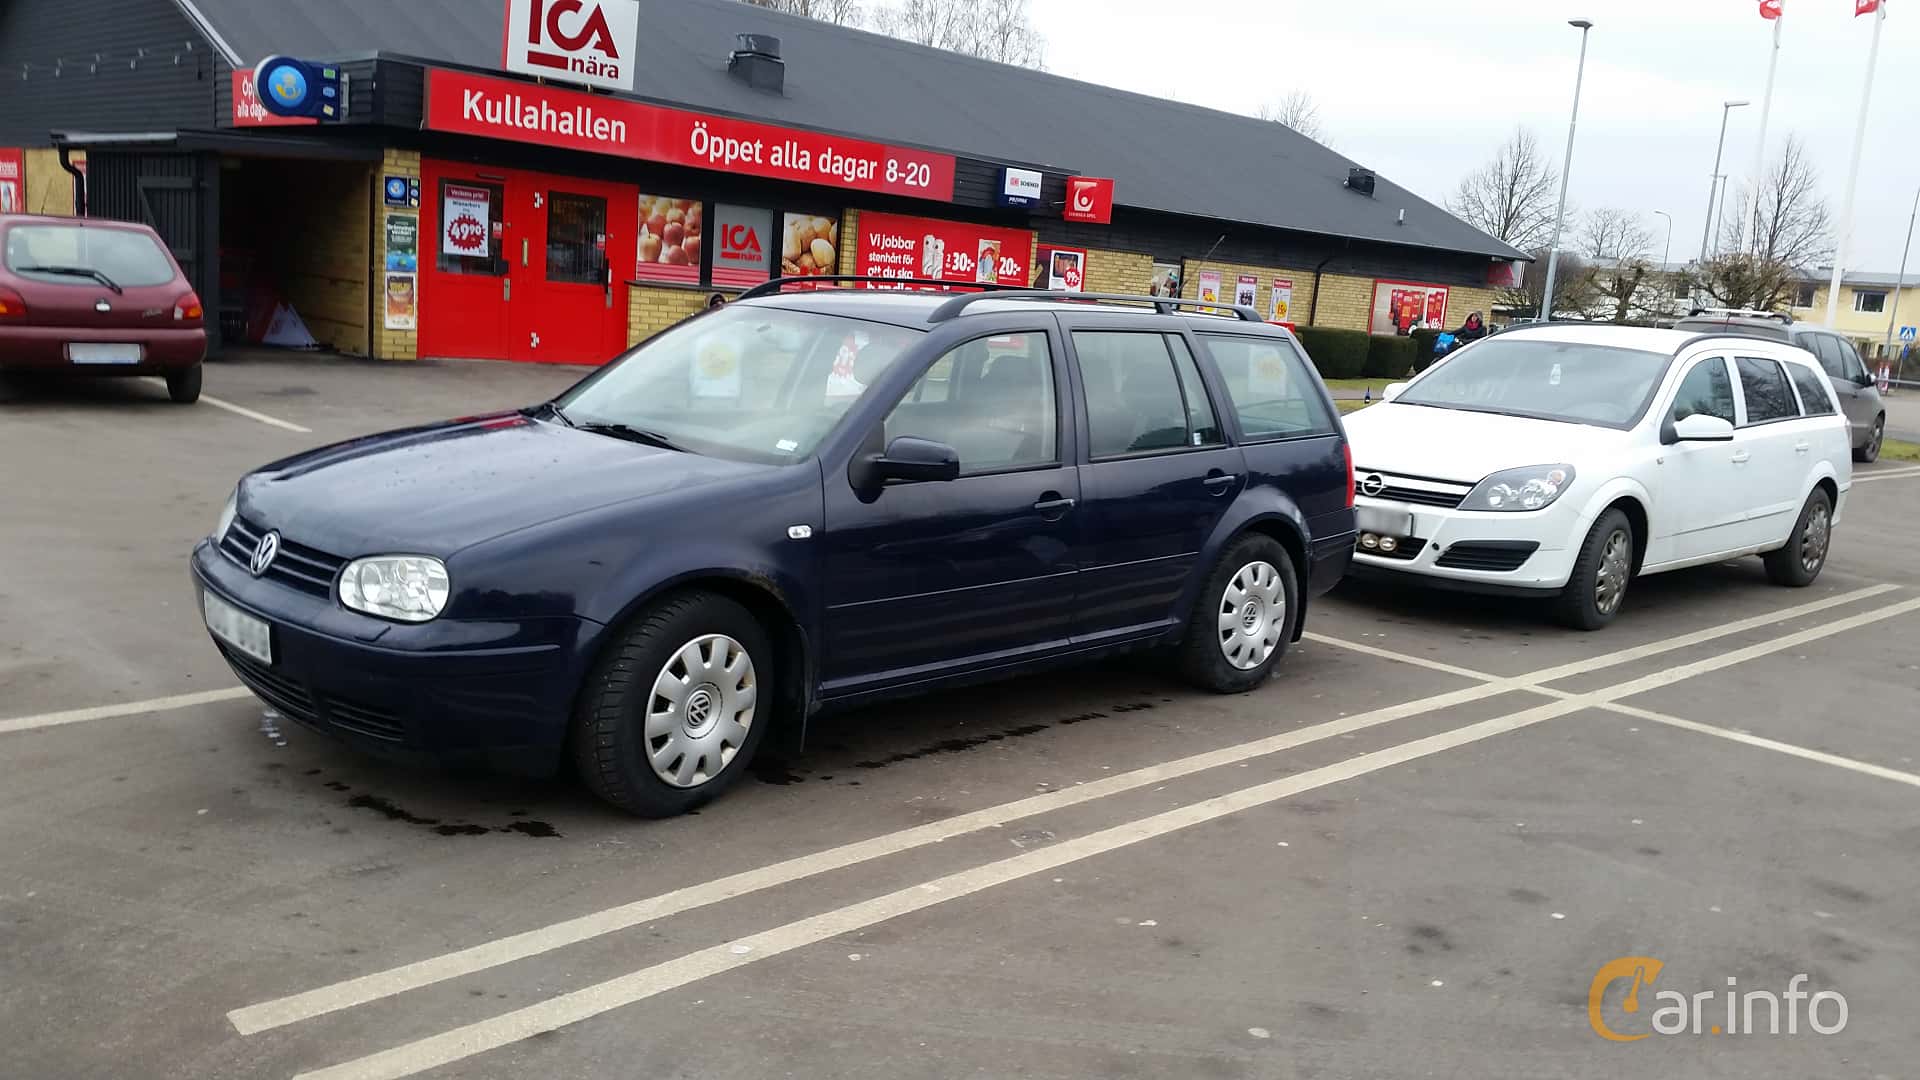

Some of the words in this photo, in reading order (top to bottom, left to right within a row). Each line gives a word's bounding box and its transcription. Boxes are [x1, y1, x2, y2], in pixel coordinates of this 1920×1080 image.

[528, 0, 619, 59] ICA
[571, 55, 619, 80] nära
[237, 99, 249, 118] alla
[463, 88, 626, 143] Kullahallen
[690, 120, 763, 166] Öppet
[770, 140, 811, 171] alla
[818, 147, 878, 183] dagar
[886, 158, 931, 188] 8-20
[721, 223, 762, 253] ICA
[869, 232, 881, 247] Vi
[880, 233, 916, 250] jobbar
[740, 252, 763, 263] nära
[868, 251, 902, 265] stenhårt
[902, 253, 914, 265] för
[952, 251, 975, 272] 30:-
[998, 256, 1021, 276] 20:-
[882, 265, 896, 278] du
[897, 267, 914, 279] ska
